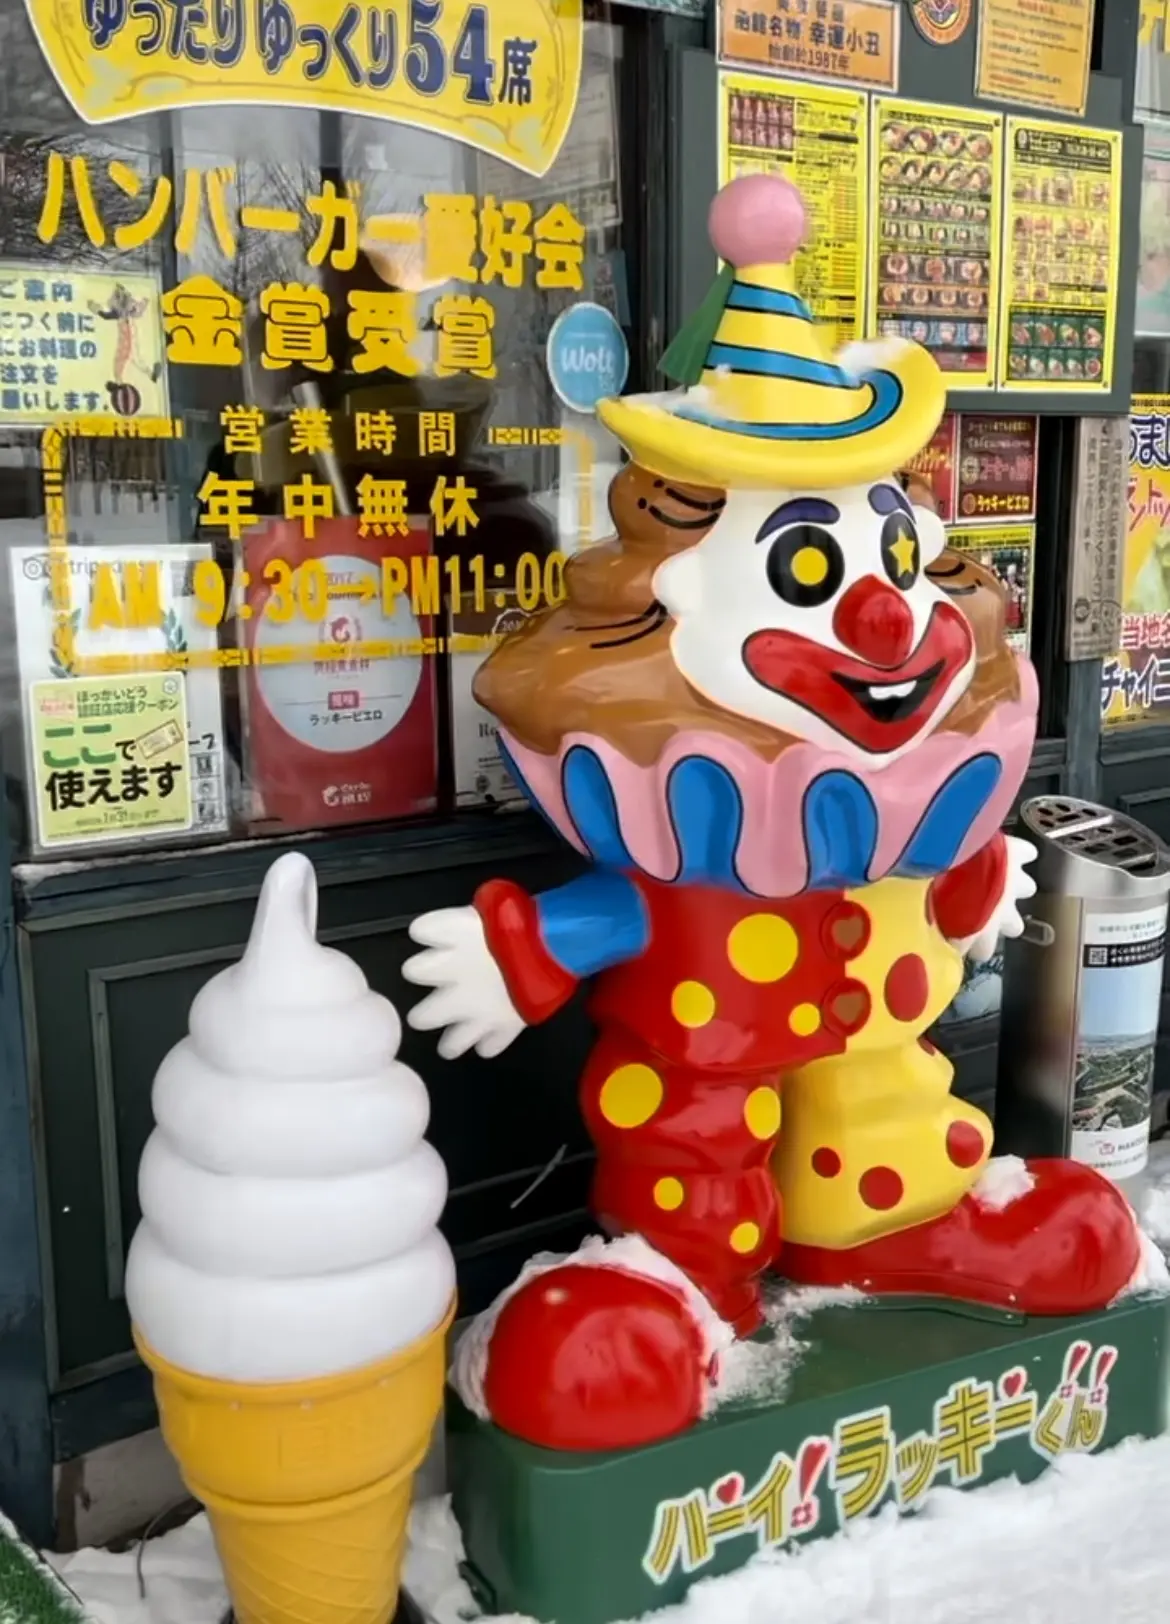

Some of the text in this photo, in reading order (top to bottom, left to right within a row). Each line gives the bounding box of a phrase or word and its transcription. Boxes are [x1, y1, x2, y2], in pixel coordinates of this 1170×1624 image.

[37, 151, 585, 291] ハンバーガー愛好会
[163, 274, 497, 379] 金賞受賞
[219, 404, 457, 456] 営業時間
[197, 472, 480, 539] 年中無休
[88, 560, 164, 632] AM
[43, 723, 137, 768] ここで
[45, 761, 182, 812] 使えます
